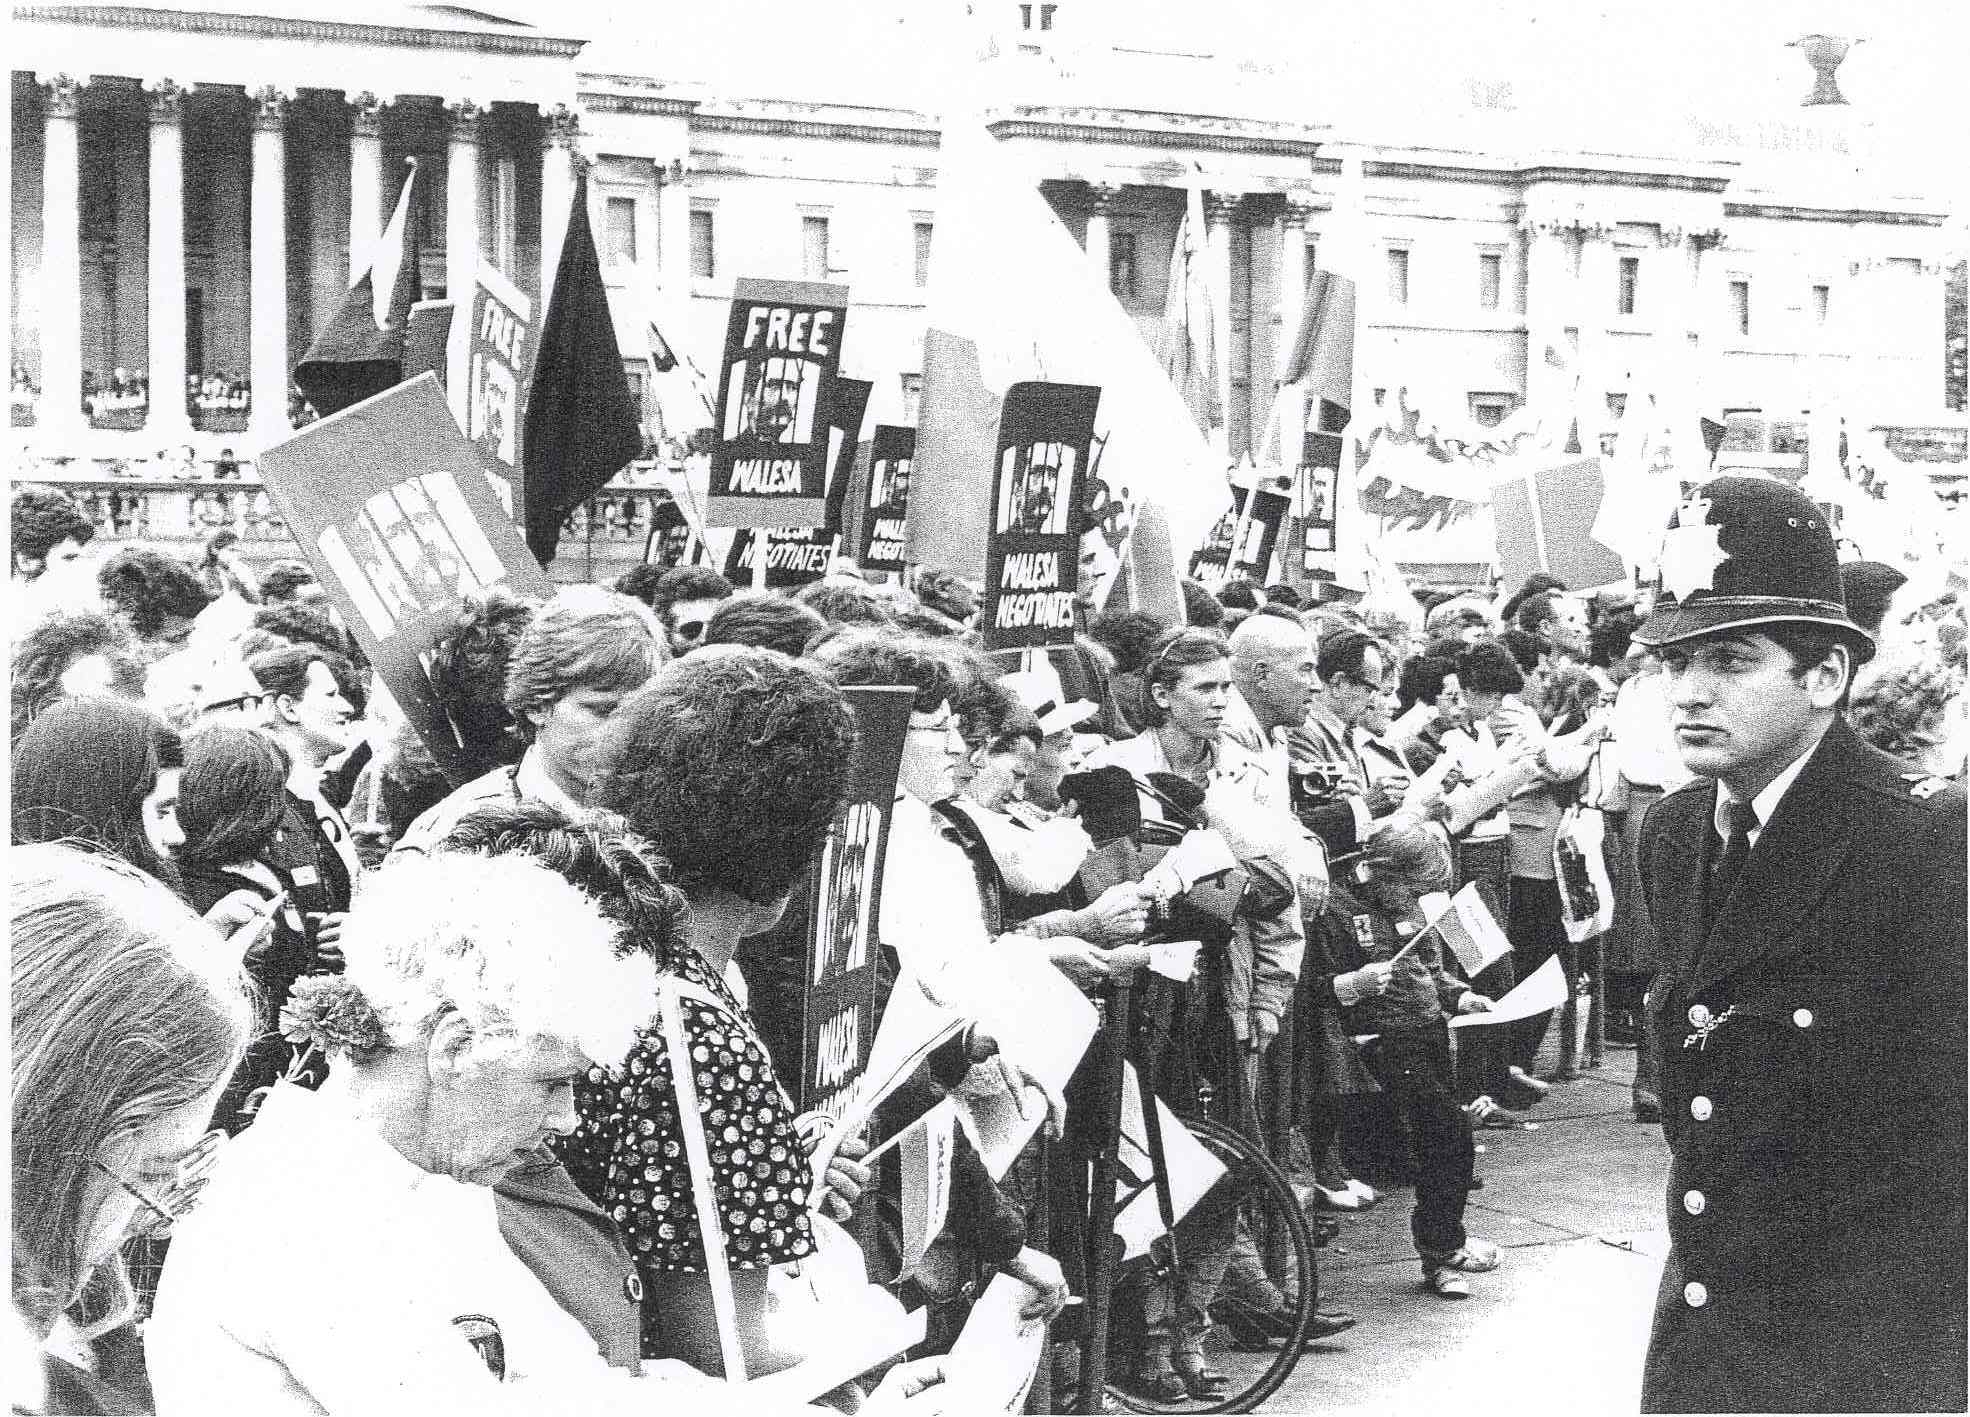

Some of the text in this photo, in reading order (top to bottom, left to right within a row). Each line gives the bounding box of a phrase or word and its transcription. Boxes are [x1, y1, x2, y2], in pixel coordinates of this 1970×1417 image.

[480, 298, 526, 371] FREE
[743, 306, 833, 356] FREE
[728, 458, 802, 494] WALESA
[1001, 552, 1059, 591] WALESA
[995, 591, 1077, 629] NEGOTIATES
